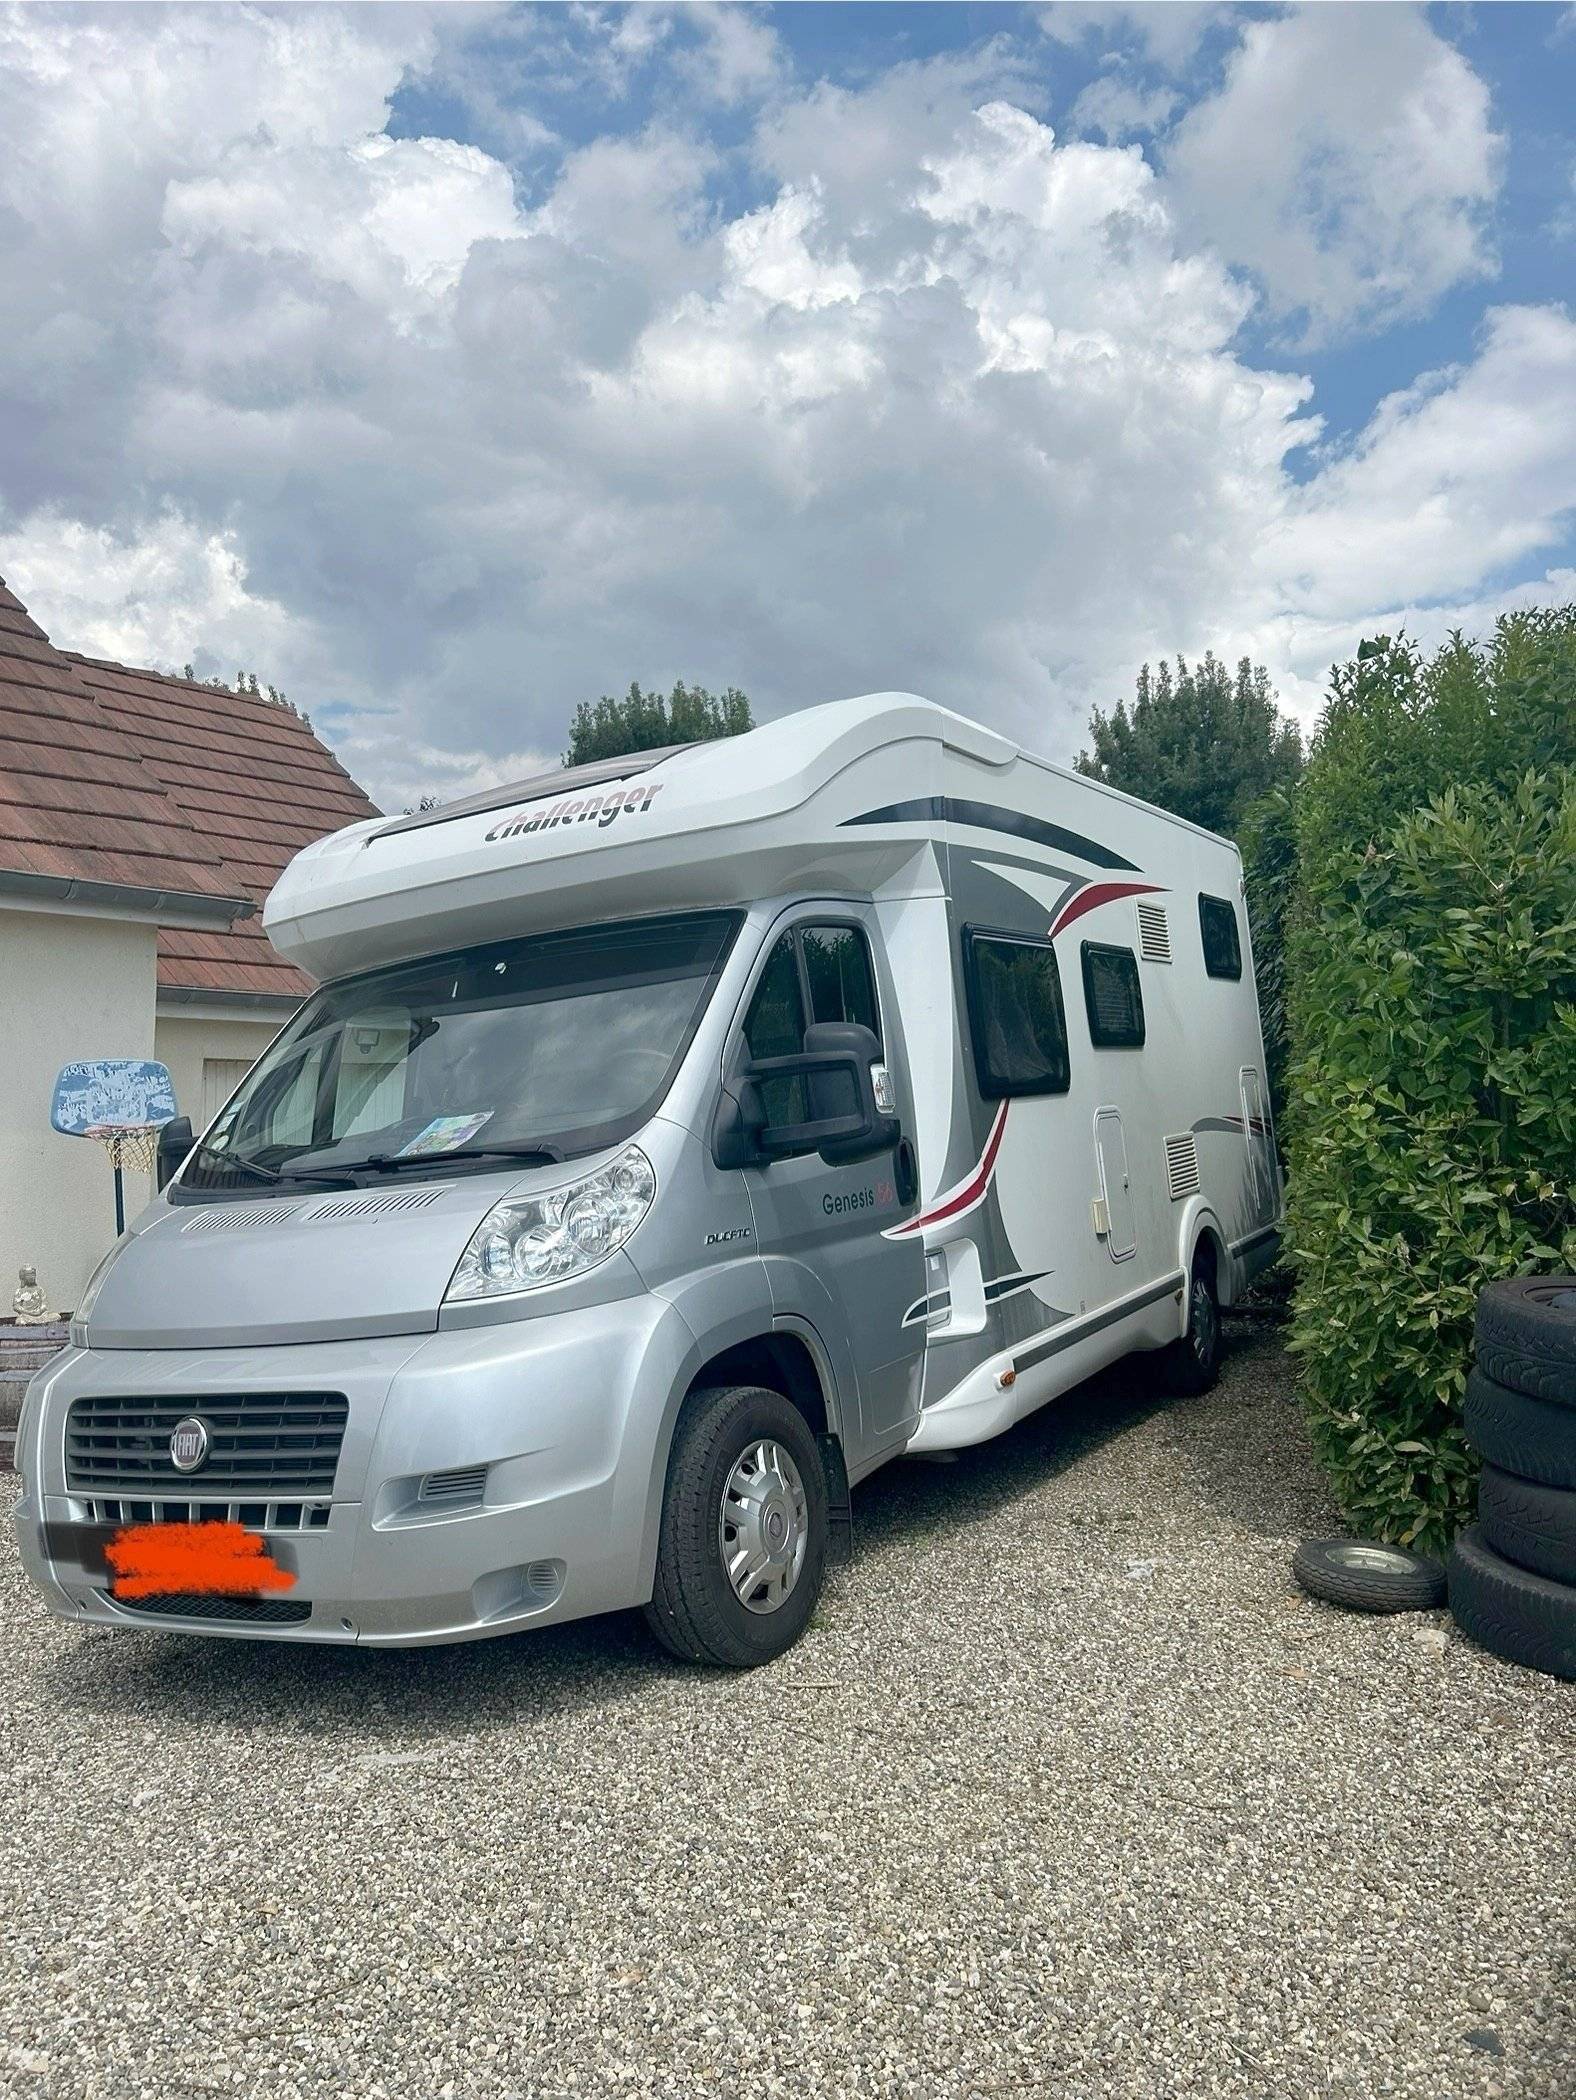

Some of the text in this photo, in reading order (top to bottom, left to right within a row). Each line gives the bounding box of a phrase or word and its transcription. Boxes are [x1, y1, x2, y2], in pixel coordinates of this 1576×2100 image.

[484, 784, 664, 842] Challenger
[822, 1187, 874, 1216] Genesis
[177, 1433, 199, 1456] FIAT
